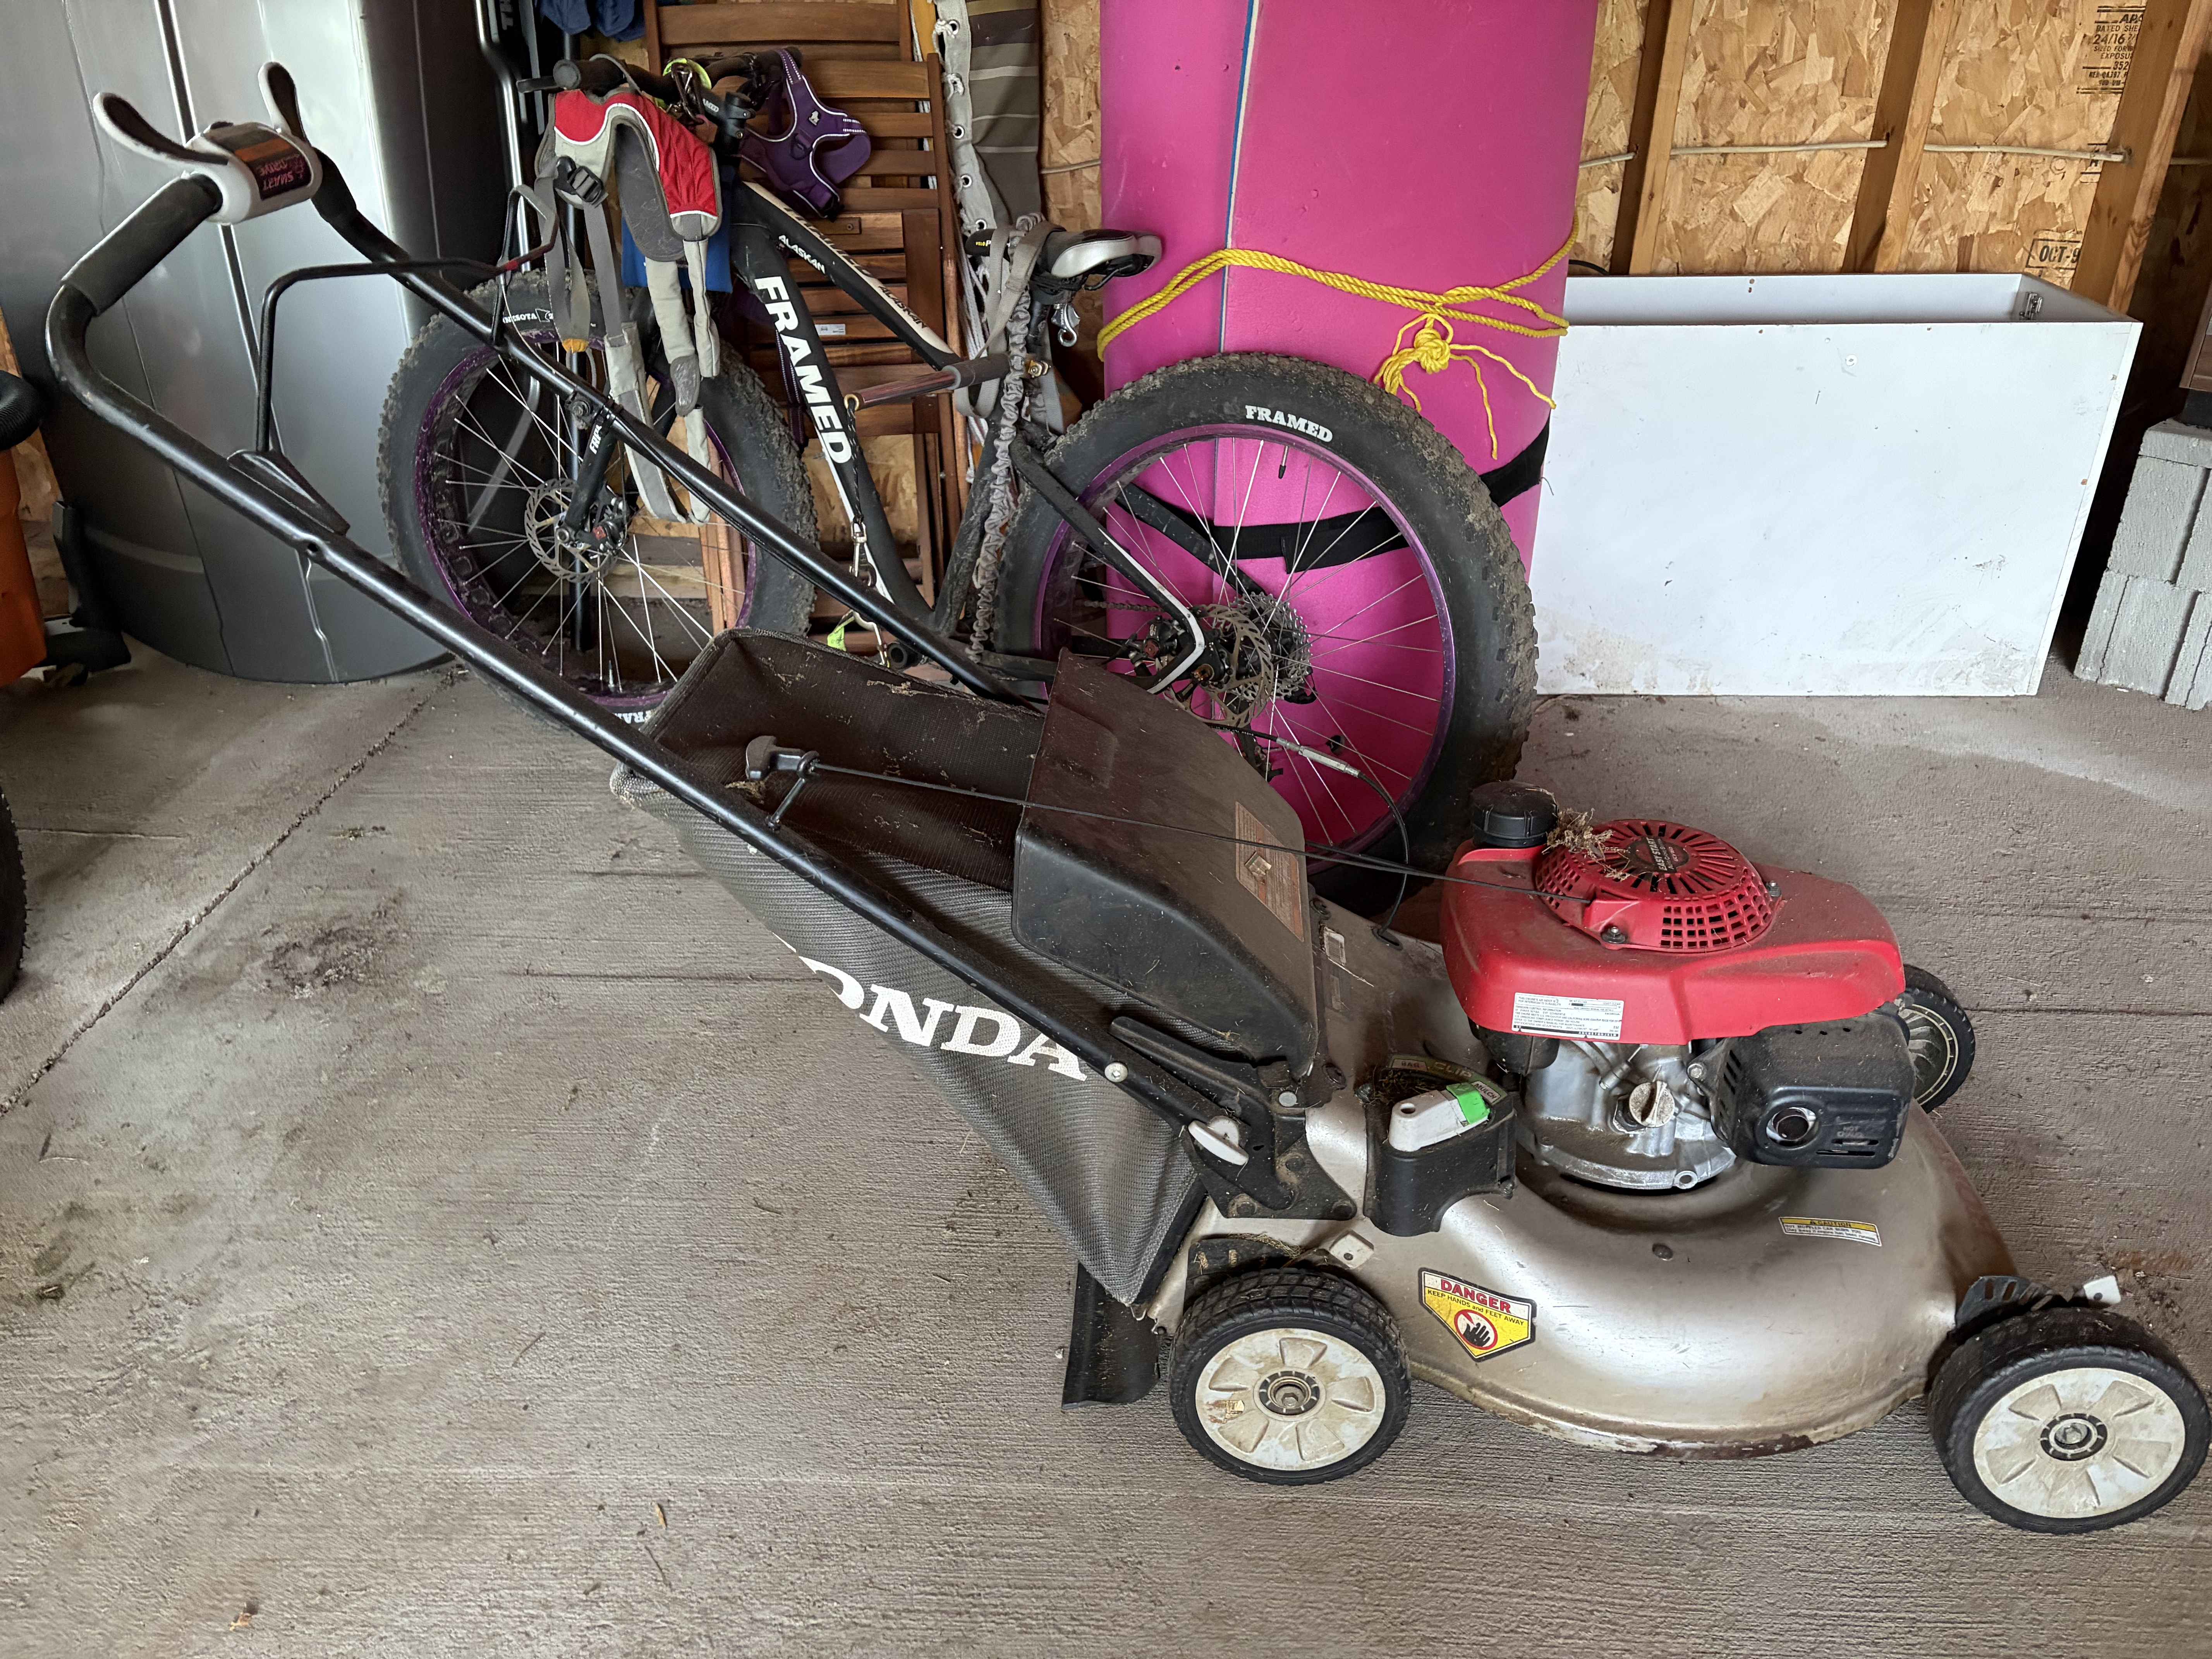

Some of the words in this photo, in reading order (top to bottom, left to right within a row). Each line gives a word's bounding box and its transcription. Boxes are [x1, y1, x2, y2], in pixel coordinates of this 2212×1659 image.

[2093, 34, 2126, 45] 24/16
[263, 172, 294, 190] SMART
[778, 235, 825, 274] ALASKAN
[878, 286, 928, 329] ALASKAN
[754, 276, 852, 464] FRAMED
[1245, 405, 1333, 442] FRAMED
[1646, 837, 1661, 855] START
[1654, 854, 1668, 871] EASY
[772, 932, 1087, 1081] ONDA
[1434, 1061, 1472, 1078] CLIP
[1474, 1084, 1497, 1099] MULCH
[1427, 1289, 1446, 1298] KEEP
[1448, 1295, 1471, 1308] HANDS
[1472, 1305, 1484, 1313] and
[1486, 1309, 1502, 1319] FEET
[1504, 1316, 1525, 1326] AWAY
[1441, 1279, 1511, 1314] DANGER
